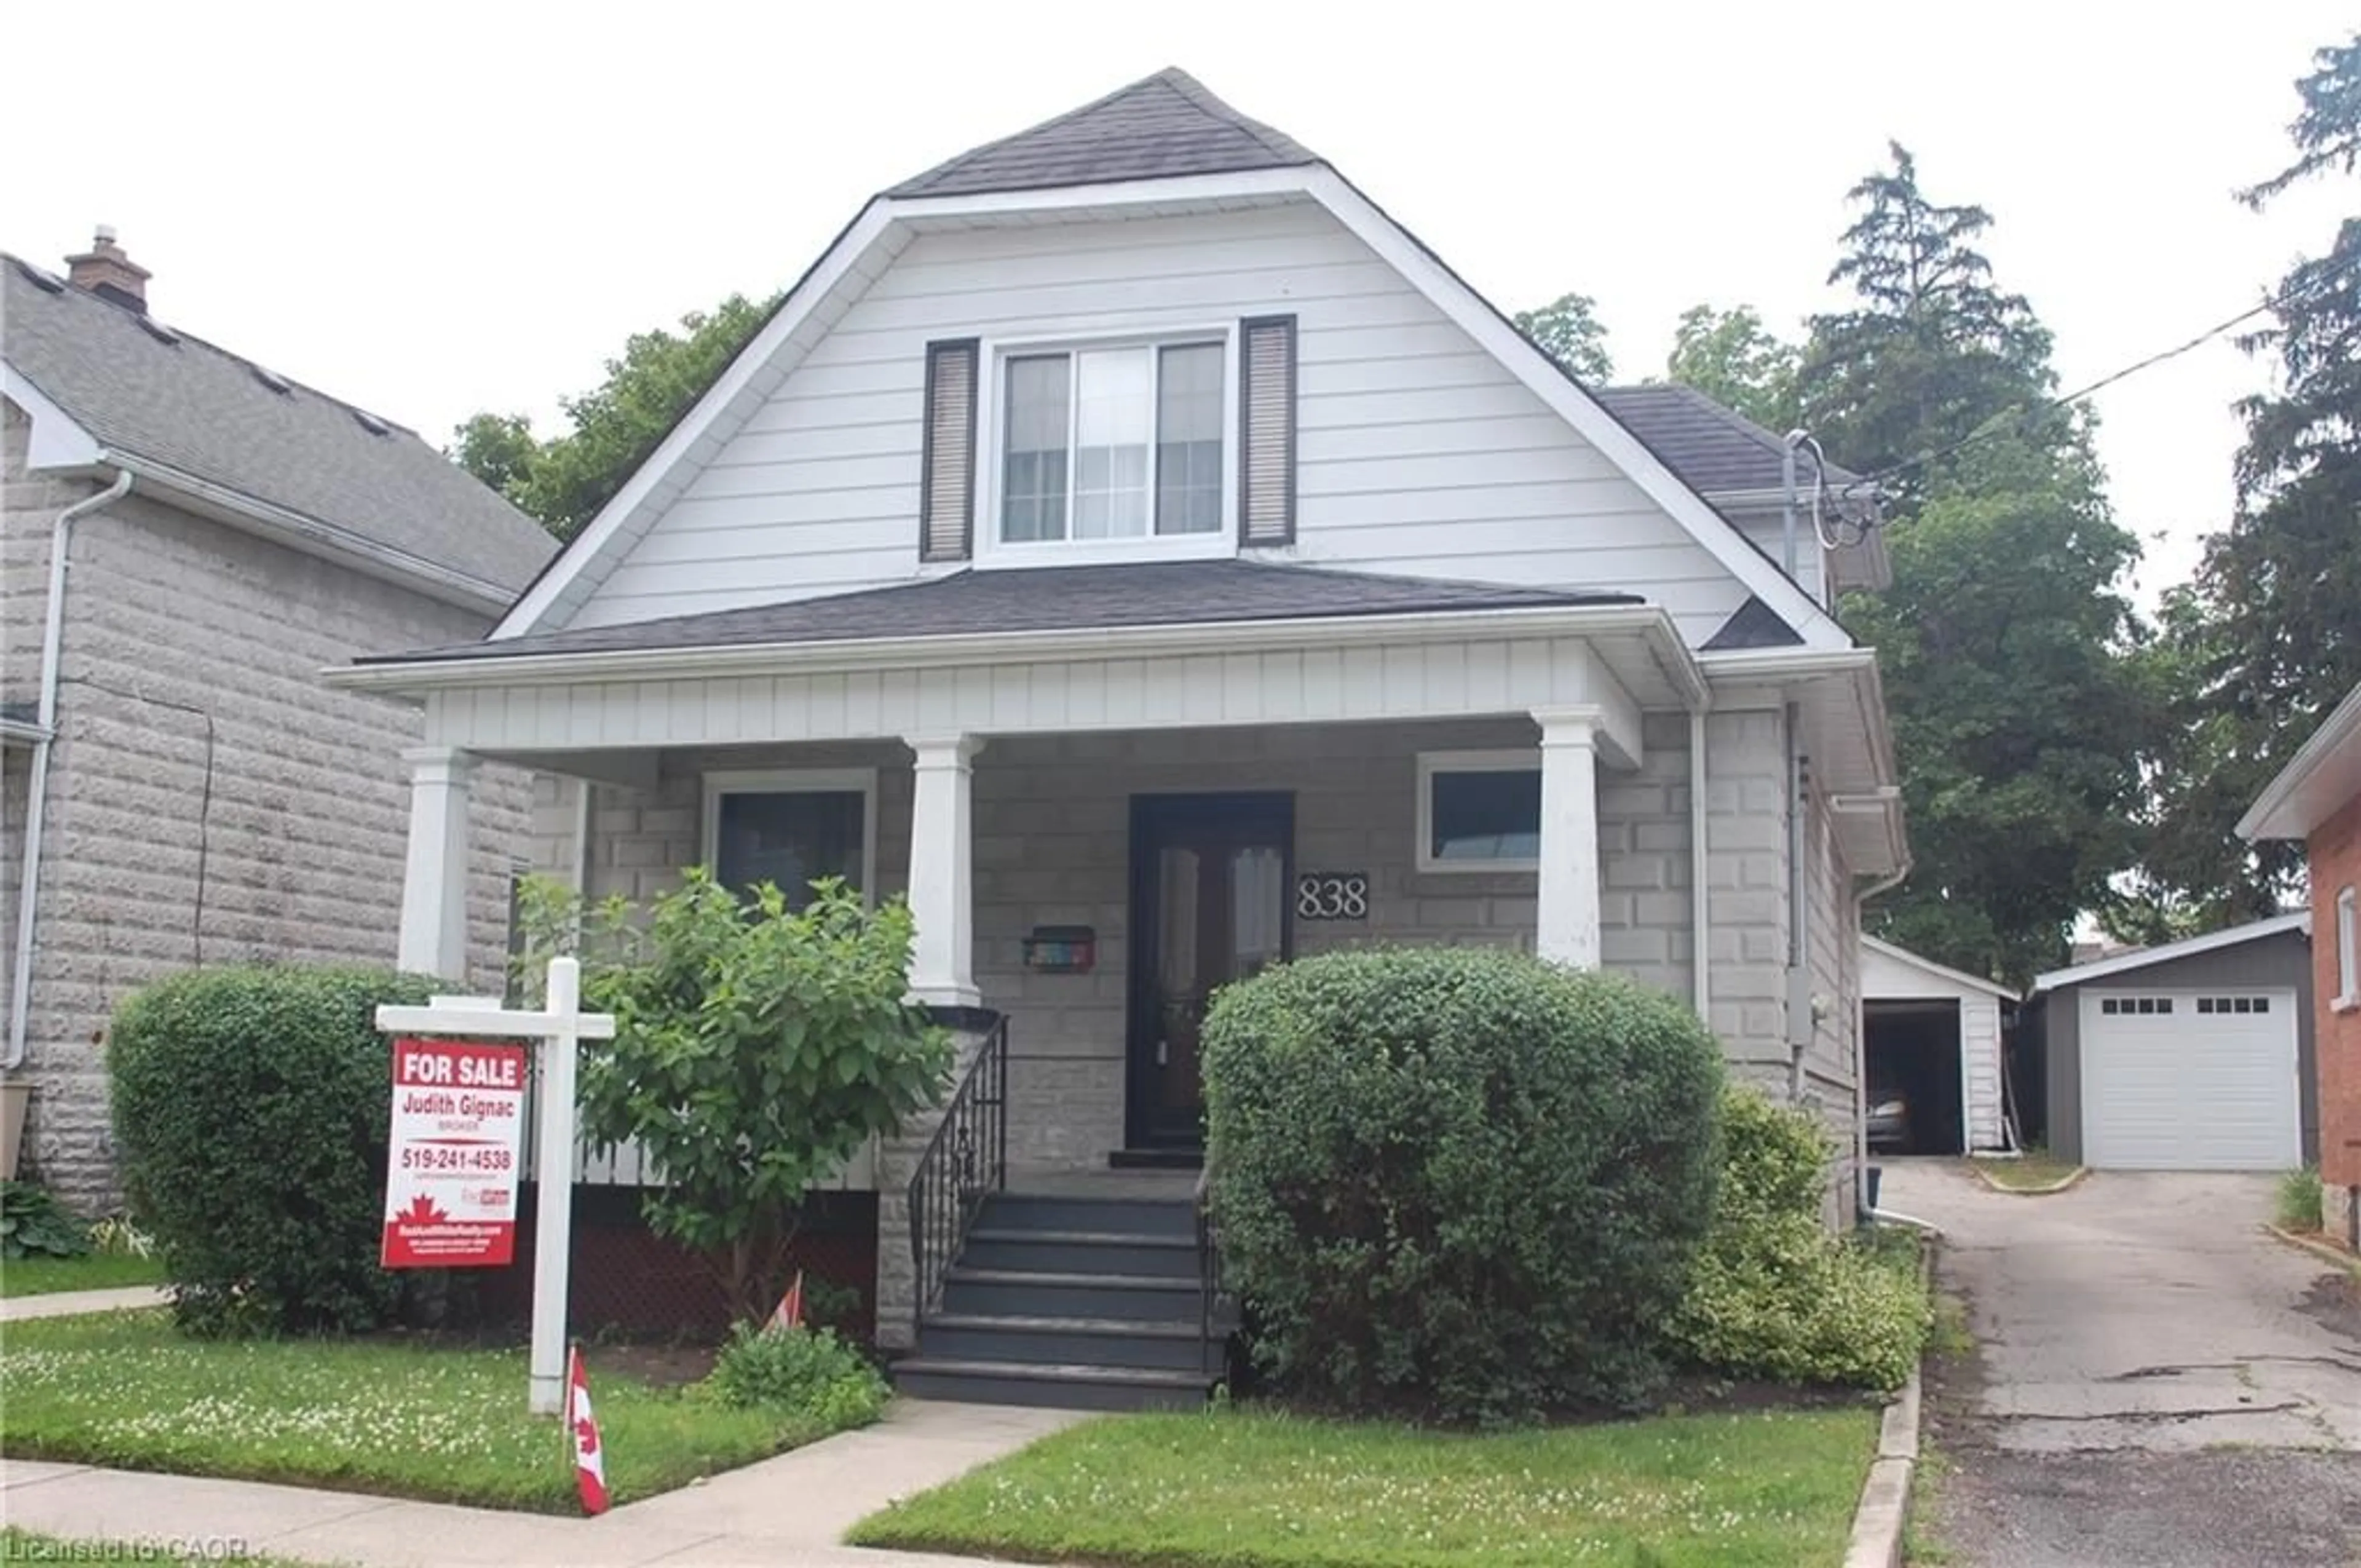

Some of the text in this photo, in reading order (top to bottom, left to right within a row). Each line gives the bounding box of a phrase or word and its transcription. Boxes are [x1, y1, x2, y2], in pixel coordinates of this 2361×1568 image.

[1299, 878, 1366, 917] 838
[403, 1053, 516, 1086] FOR SALE
[402, 1092, 515, 1122] Judith Gignac
[401, 1147, 511, 1170] 519-241-4538
